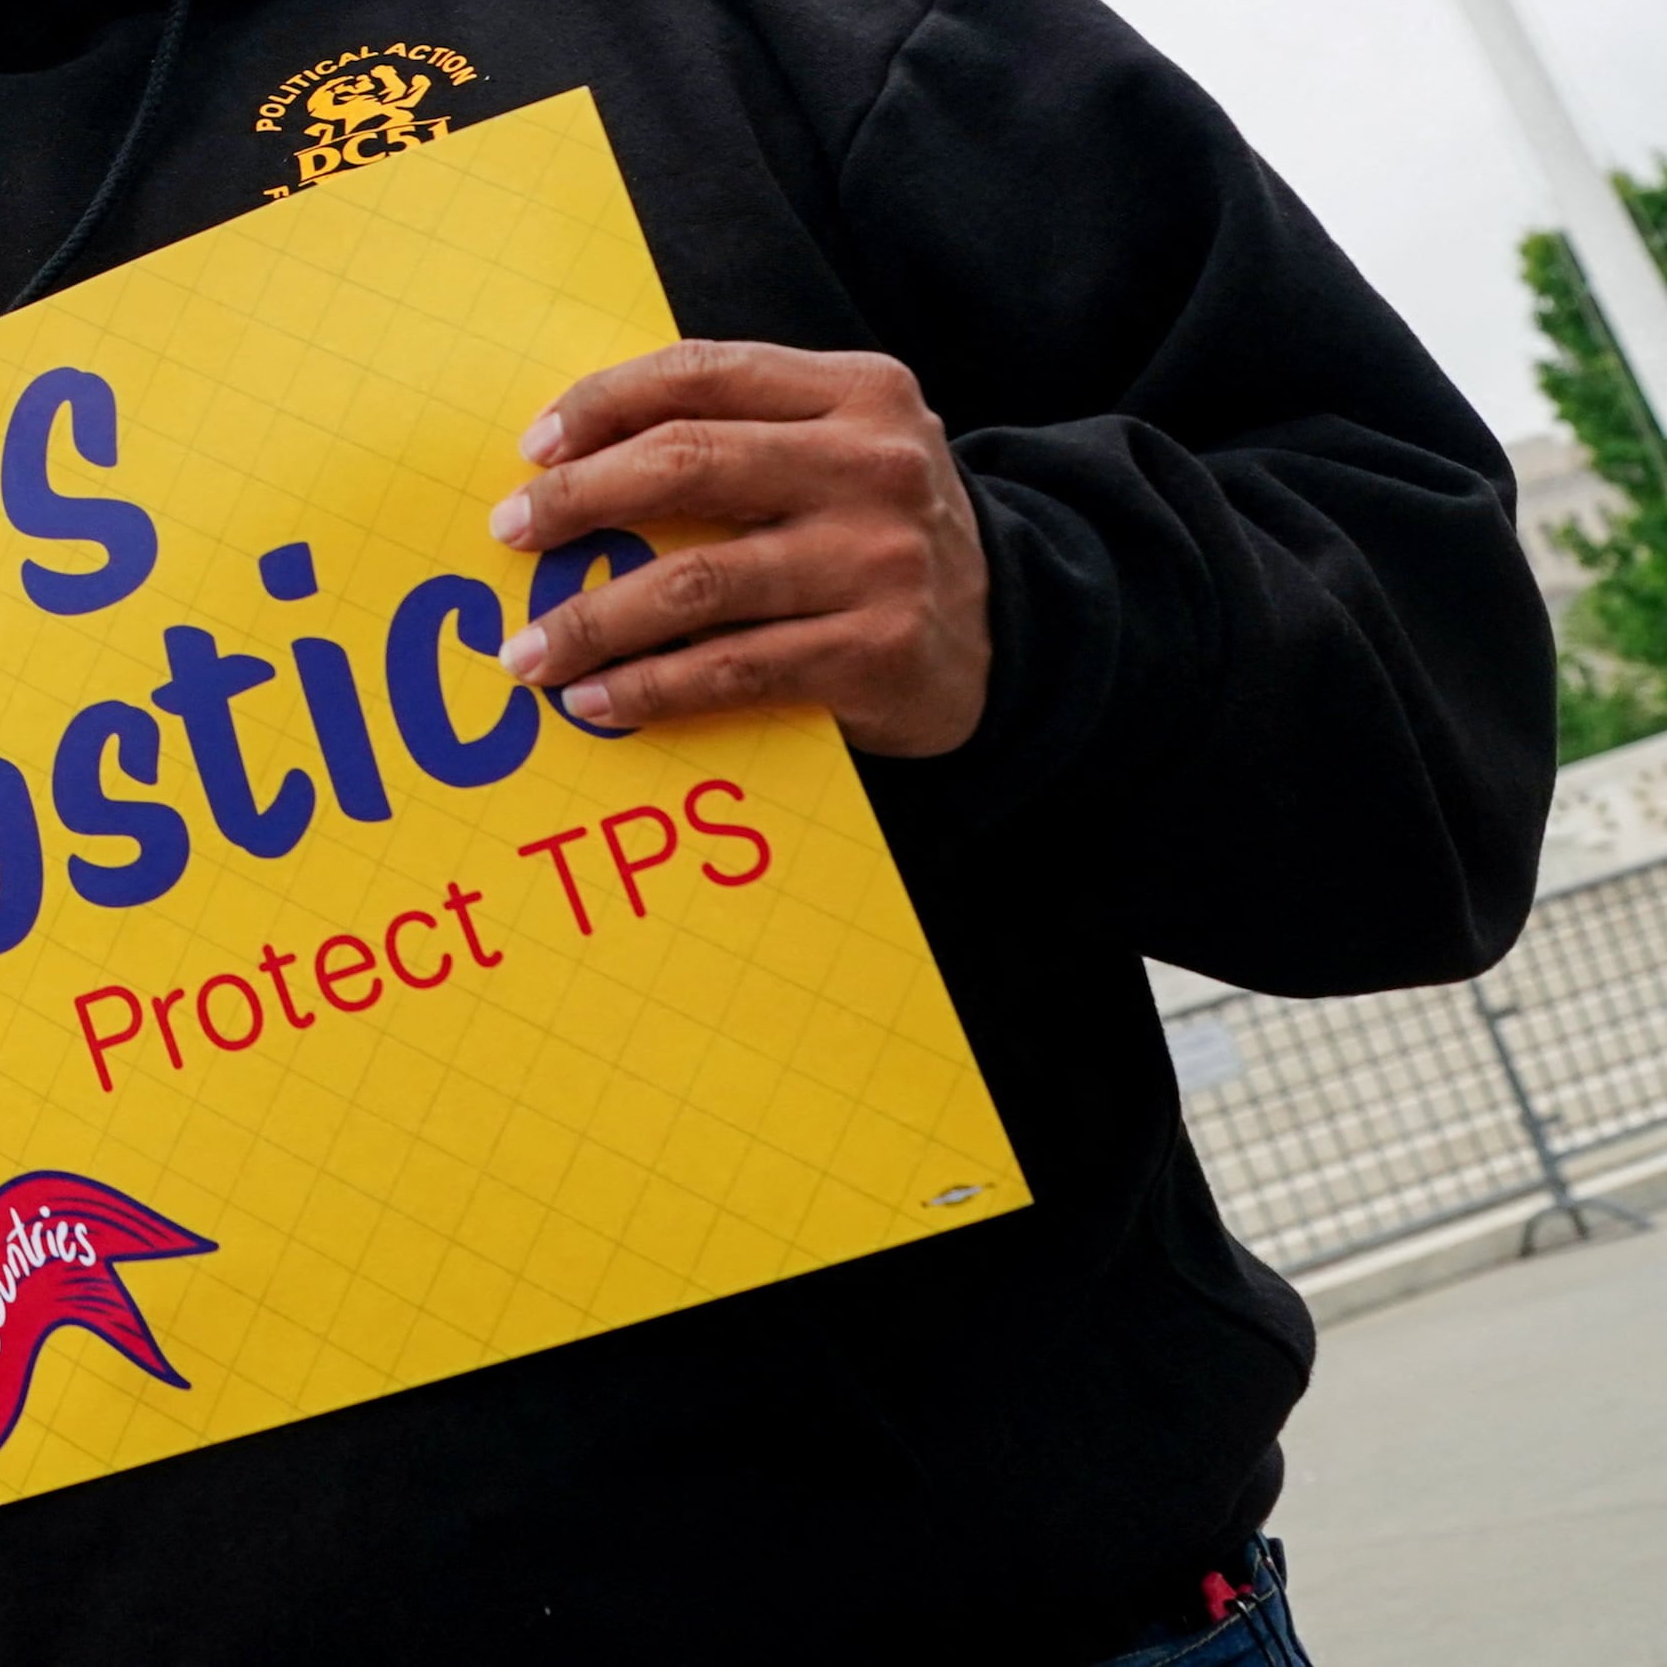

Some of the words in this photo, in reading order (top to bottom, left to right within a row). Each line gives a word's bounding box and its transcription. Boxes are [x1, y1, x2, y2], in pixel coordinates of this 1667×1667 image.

[255, 45, 379, 132] POLITICAL
[383, 42, 478, 86] ACTION
[74, 882, 503, 1093] Protect
[517, 779, 771, 936] TPS
